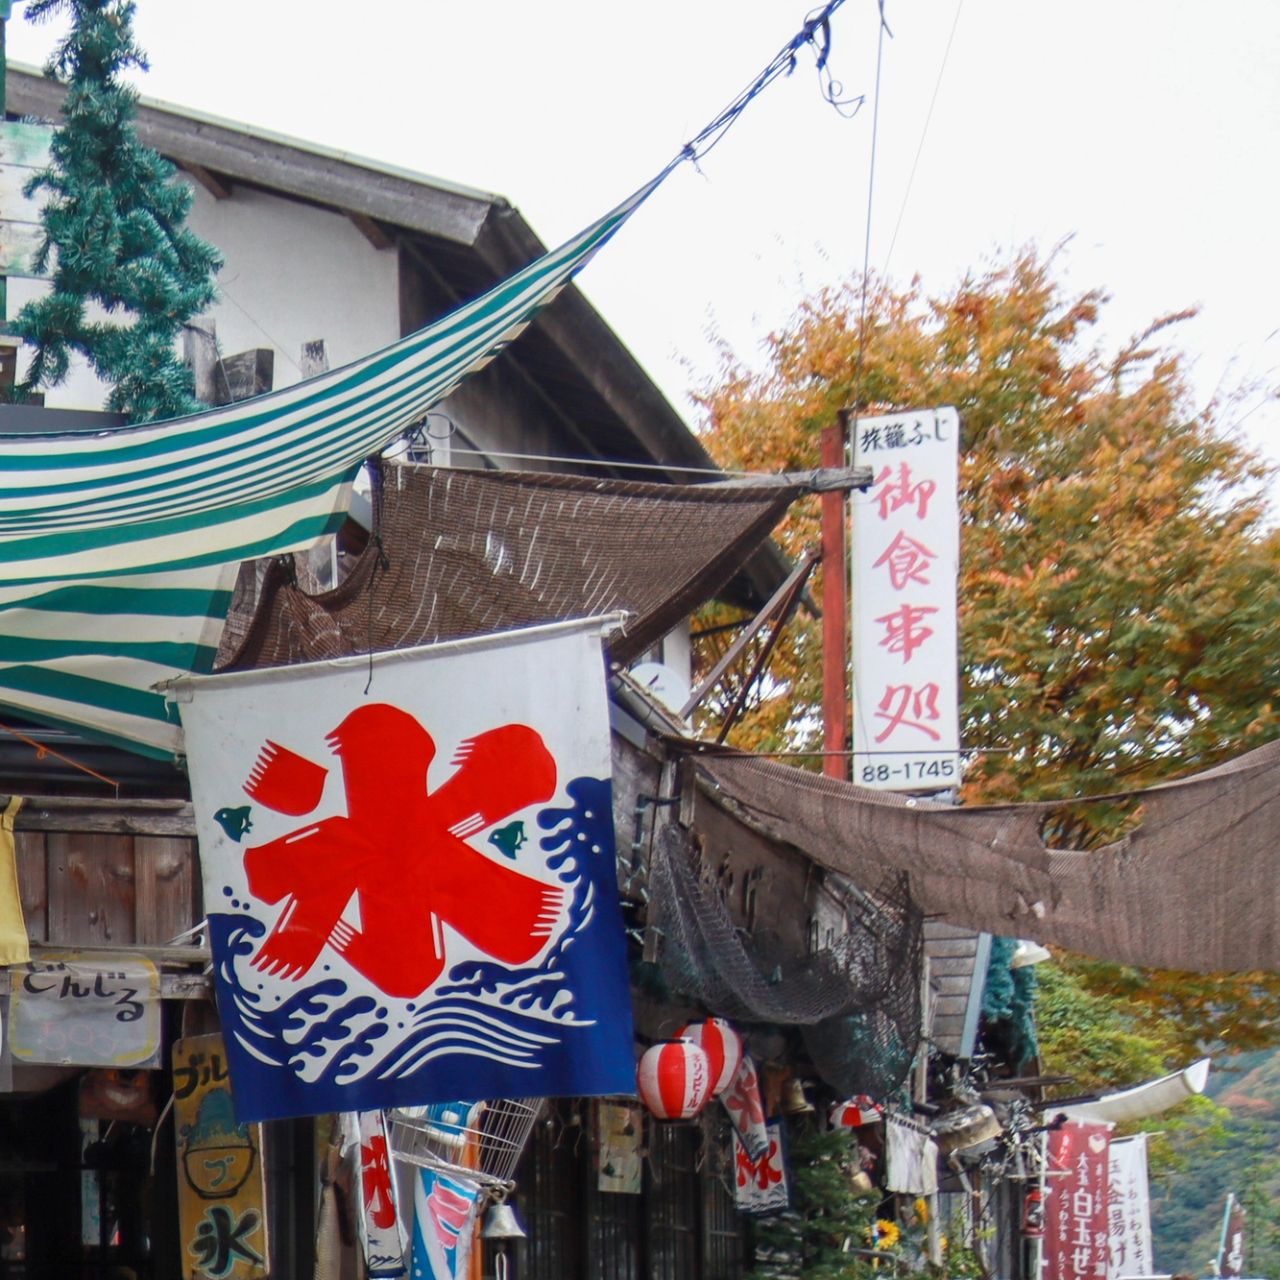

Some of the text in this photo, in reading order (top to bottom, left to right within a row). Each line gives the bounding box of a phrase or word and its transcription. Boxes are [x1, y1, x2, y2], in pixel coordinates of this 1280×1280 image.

[872, 461, 941, 744] 御食事処
[242, 702, 564, 999] 氷
[863, 760, 955, 783] 88-1745
[190, 1204, 266, 1280] 氷
